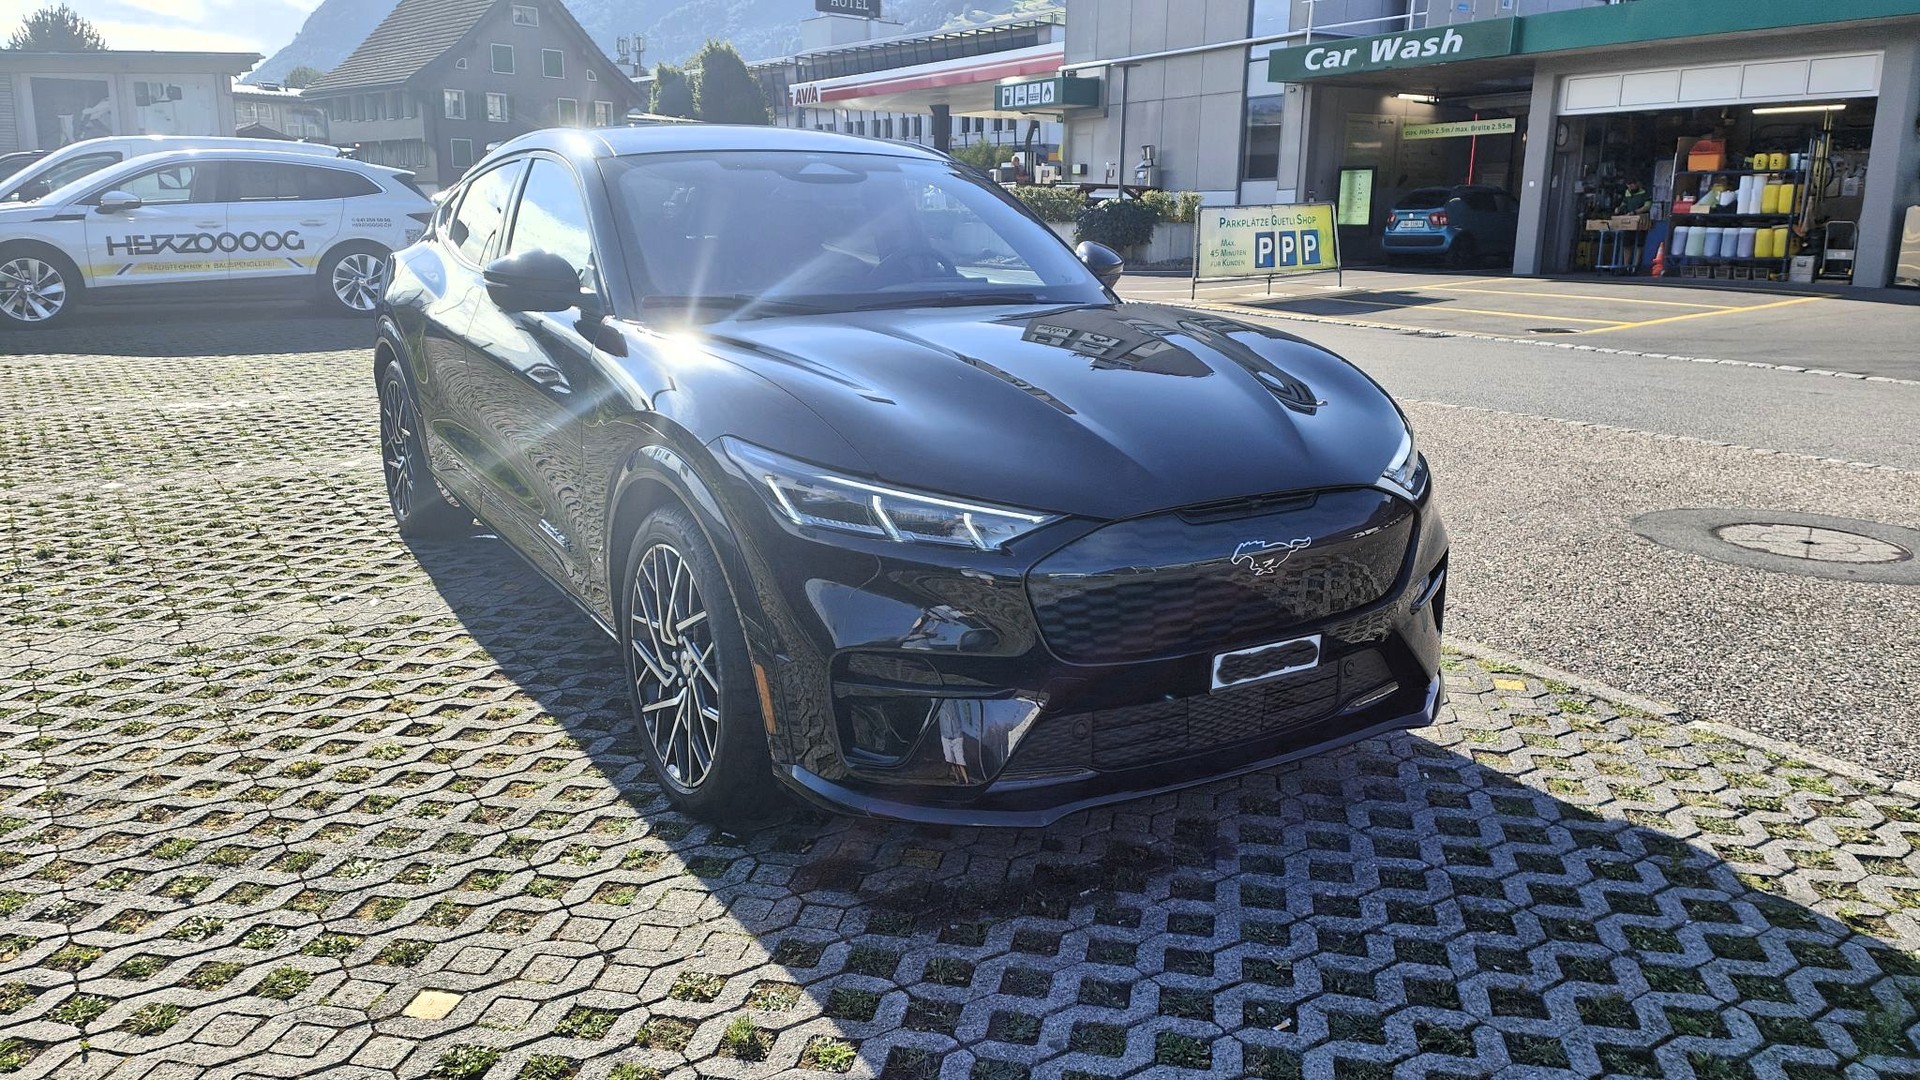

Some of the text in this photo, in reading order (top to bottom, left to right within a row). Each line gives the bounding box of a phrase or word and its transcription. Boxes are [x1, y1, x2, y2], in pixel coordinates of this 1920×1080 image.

[830, 0, 869, 10] HOTEL
[1304, 28, 1463, 71] Car Wash
[794, 84, 818, 105] AVIA
[106, 230, 305, 256] HERZOOOOG
[1258, 234, 1317, 264] P P P
